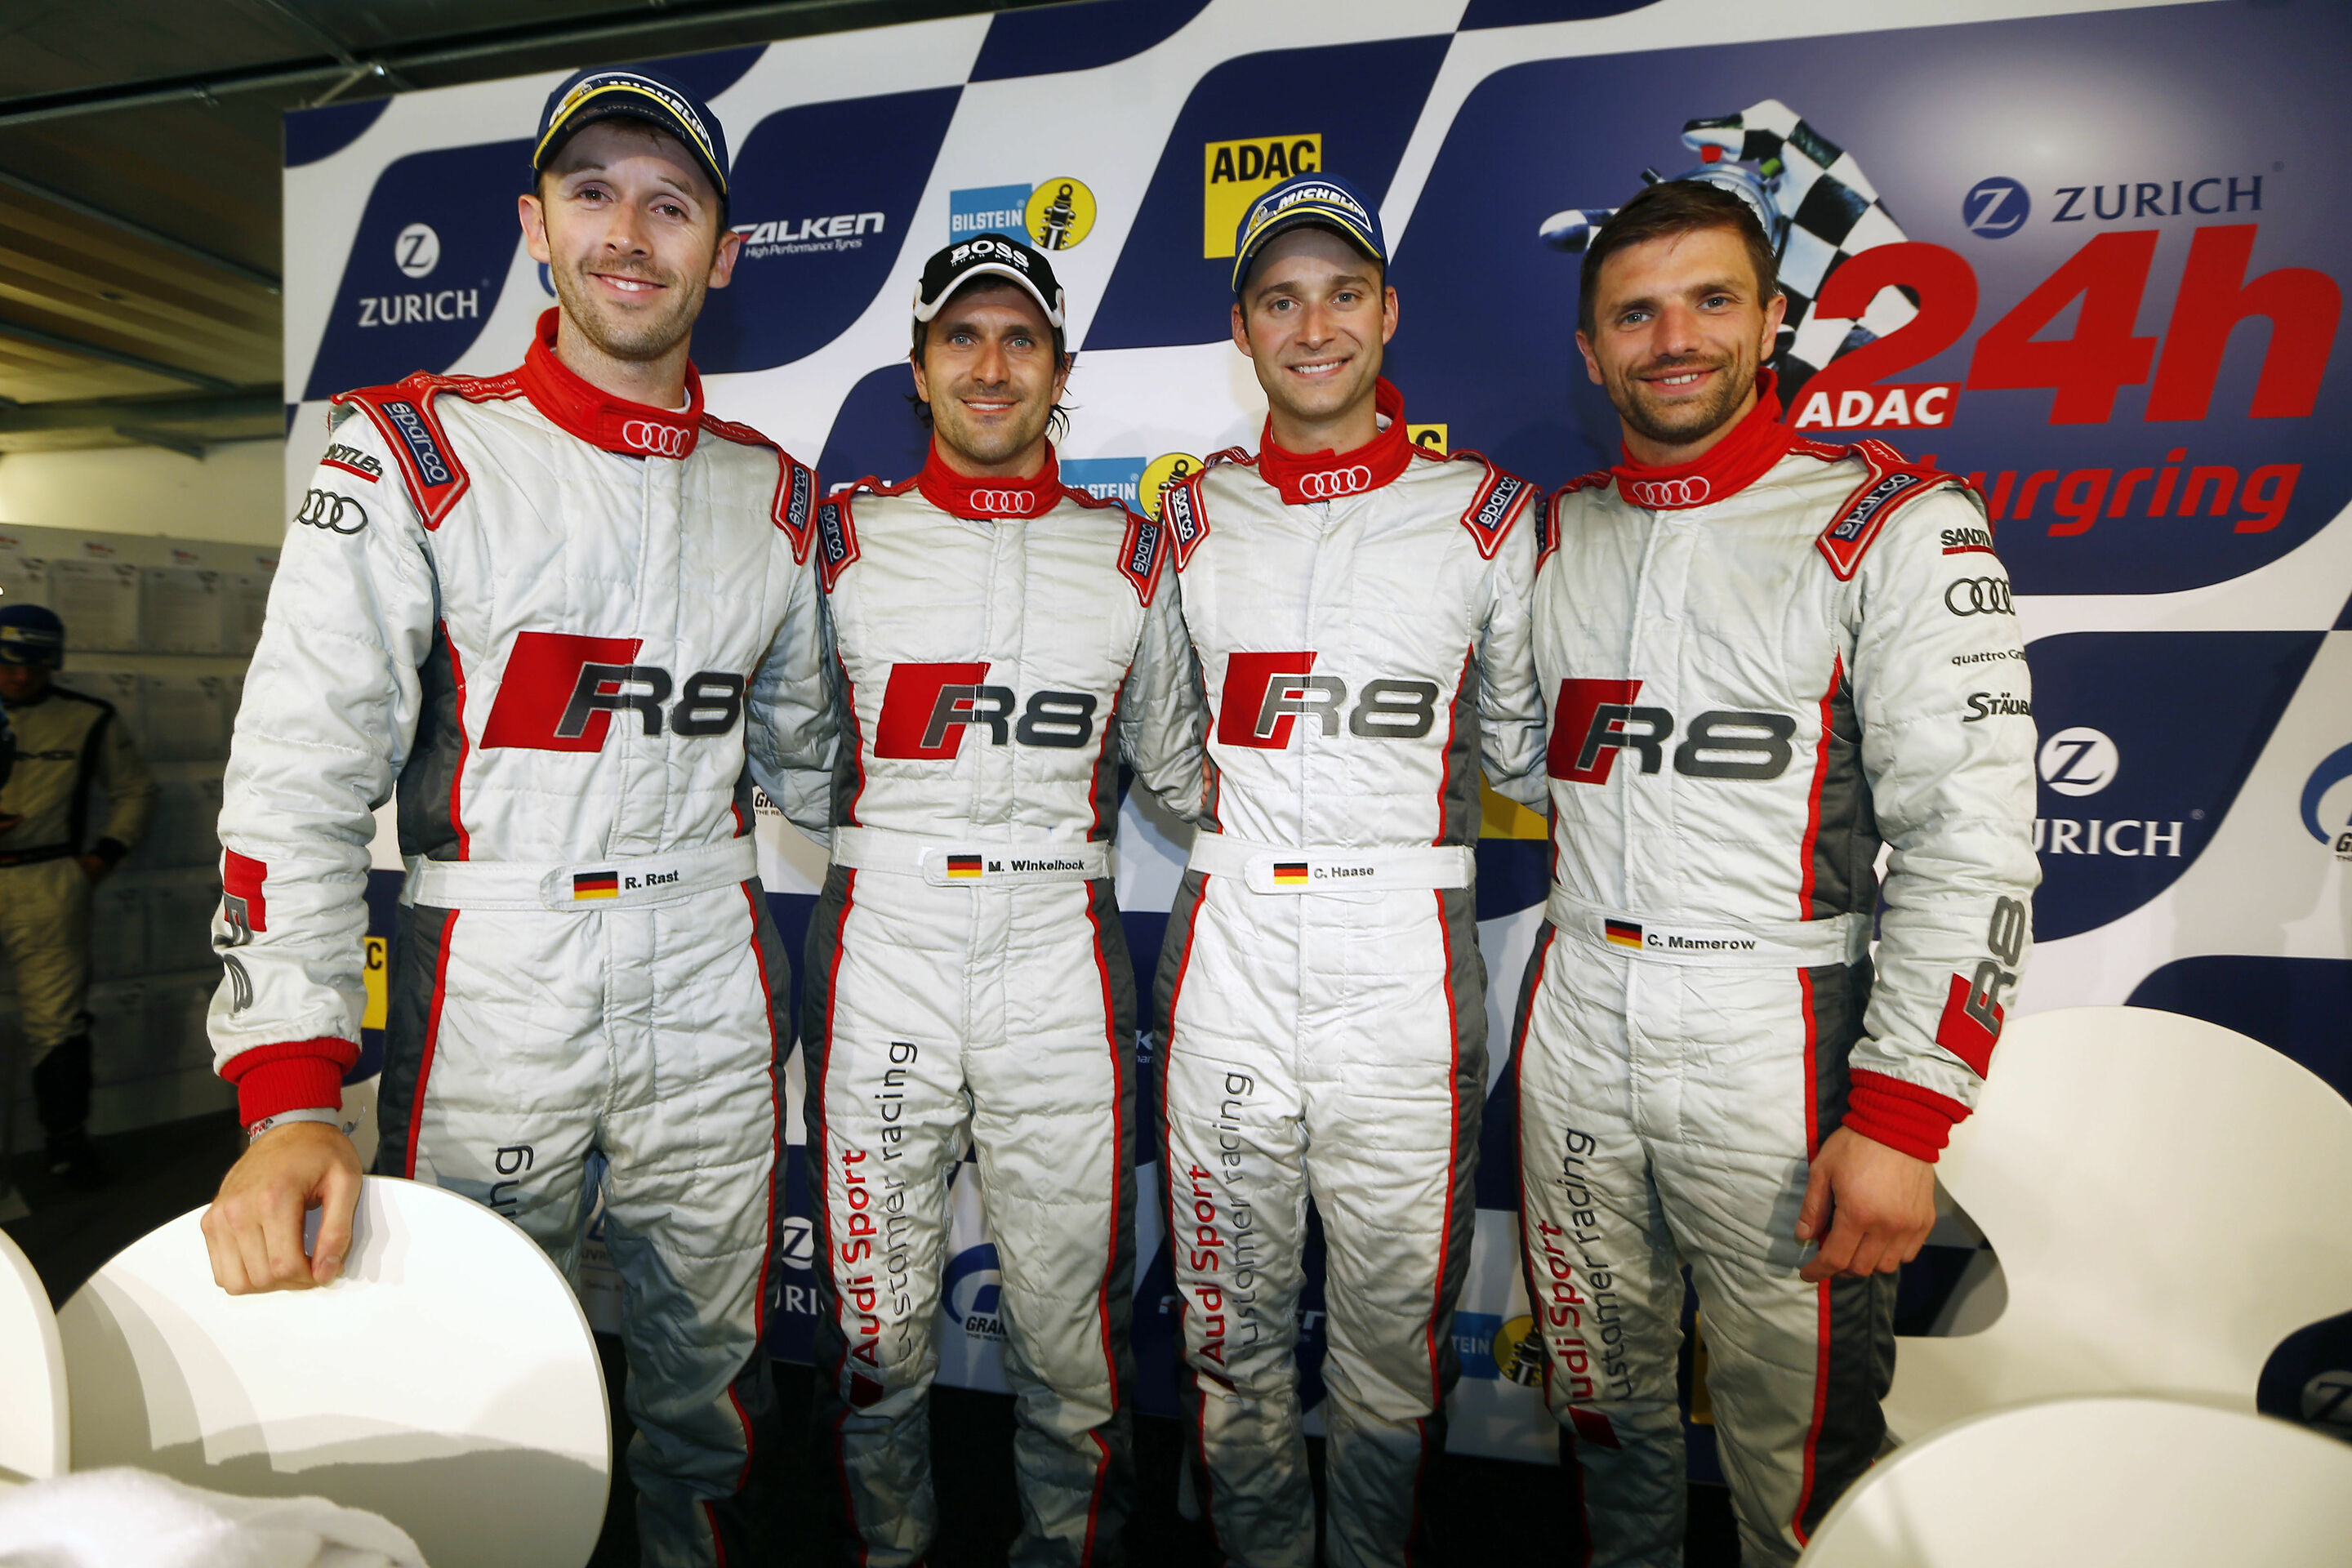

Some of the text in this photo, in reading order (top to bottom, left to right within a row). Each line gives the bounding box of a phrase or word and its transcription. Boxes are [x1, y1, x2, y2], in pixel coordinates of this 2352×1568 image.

[1211, 140, 1316, 184] ADAC
[952, 209, 1022, 232] BILSTEIN
[1278, 187, 1365, 218] MICHELIN
[2051, 176, 2263, 222] ZURICH
[731, 212, 885, 245] FALKEN
[745, 238, 862, 259] High Performance Tyres
[951, 240, 1029, 267] BOSS
[358, 288, 479, 327] ZURICH
[1784, 223, 2342, 430] 24h
[1795, 386, 1950, 428] ADAC
[391, 403, 448, 482] sparco
[789, 466, 806, 524] sparco
[1173, 487, 1195, 541] sparco
[1478, 476, 1517, 525] sparco
[1834, 474, 1910, 537] sparco
[823, 504, 844, 560] sparco
[1132, 523, 1156, 572] sparco
[1952, 653, 2007, 666] quattro
[553, 662, 746, 738] R8
[920, 684, 1098, 748] R8
[1254, 674, 1439, 739] R8
[1575, 703, 1797, 780] R8
[624, 870, 679, 889] R. Rast
[988, 860, 1085, 871] M. Winkelhock
[1313, 866, 1375, 879] C. Haase
[1646, 933, 1757, 951] C. Mamerow
[1963, 896, 2025, 1038] R8
[874, 1040, 919, 1162] racing
[1212, 1070, 1261, 1348] ustomer racing
[841, 1148, 881, 1369] Audi Sport
[1188, 1164, 1226, 1367] Audi Sport
[1557, 1127, 1633, 1402] ustomer racing
[1538, 1219, 1593, 1399] udi Sport
